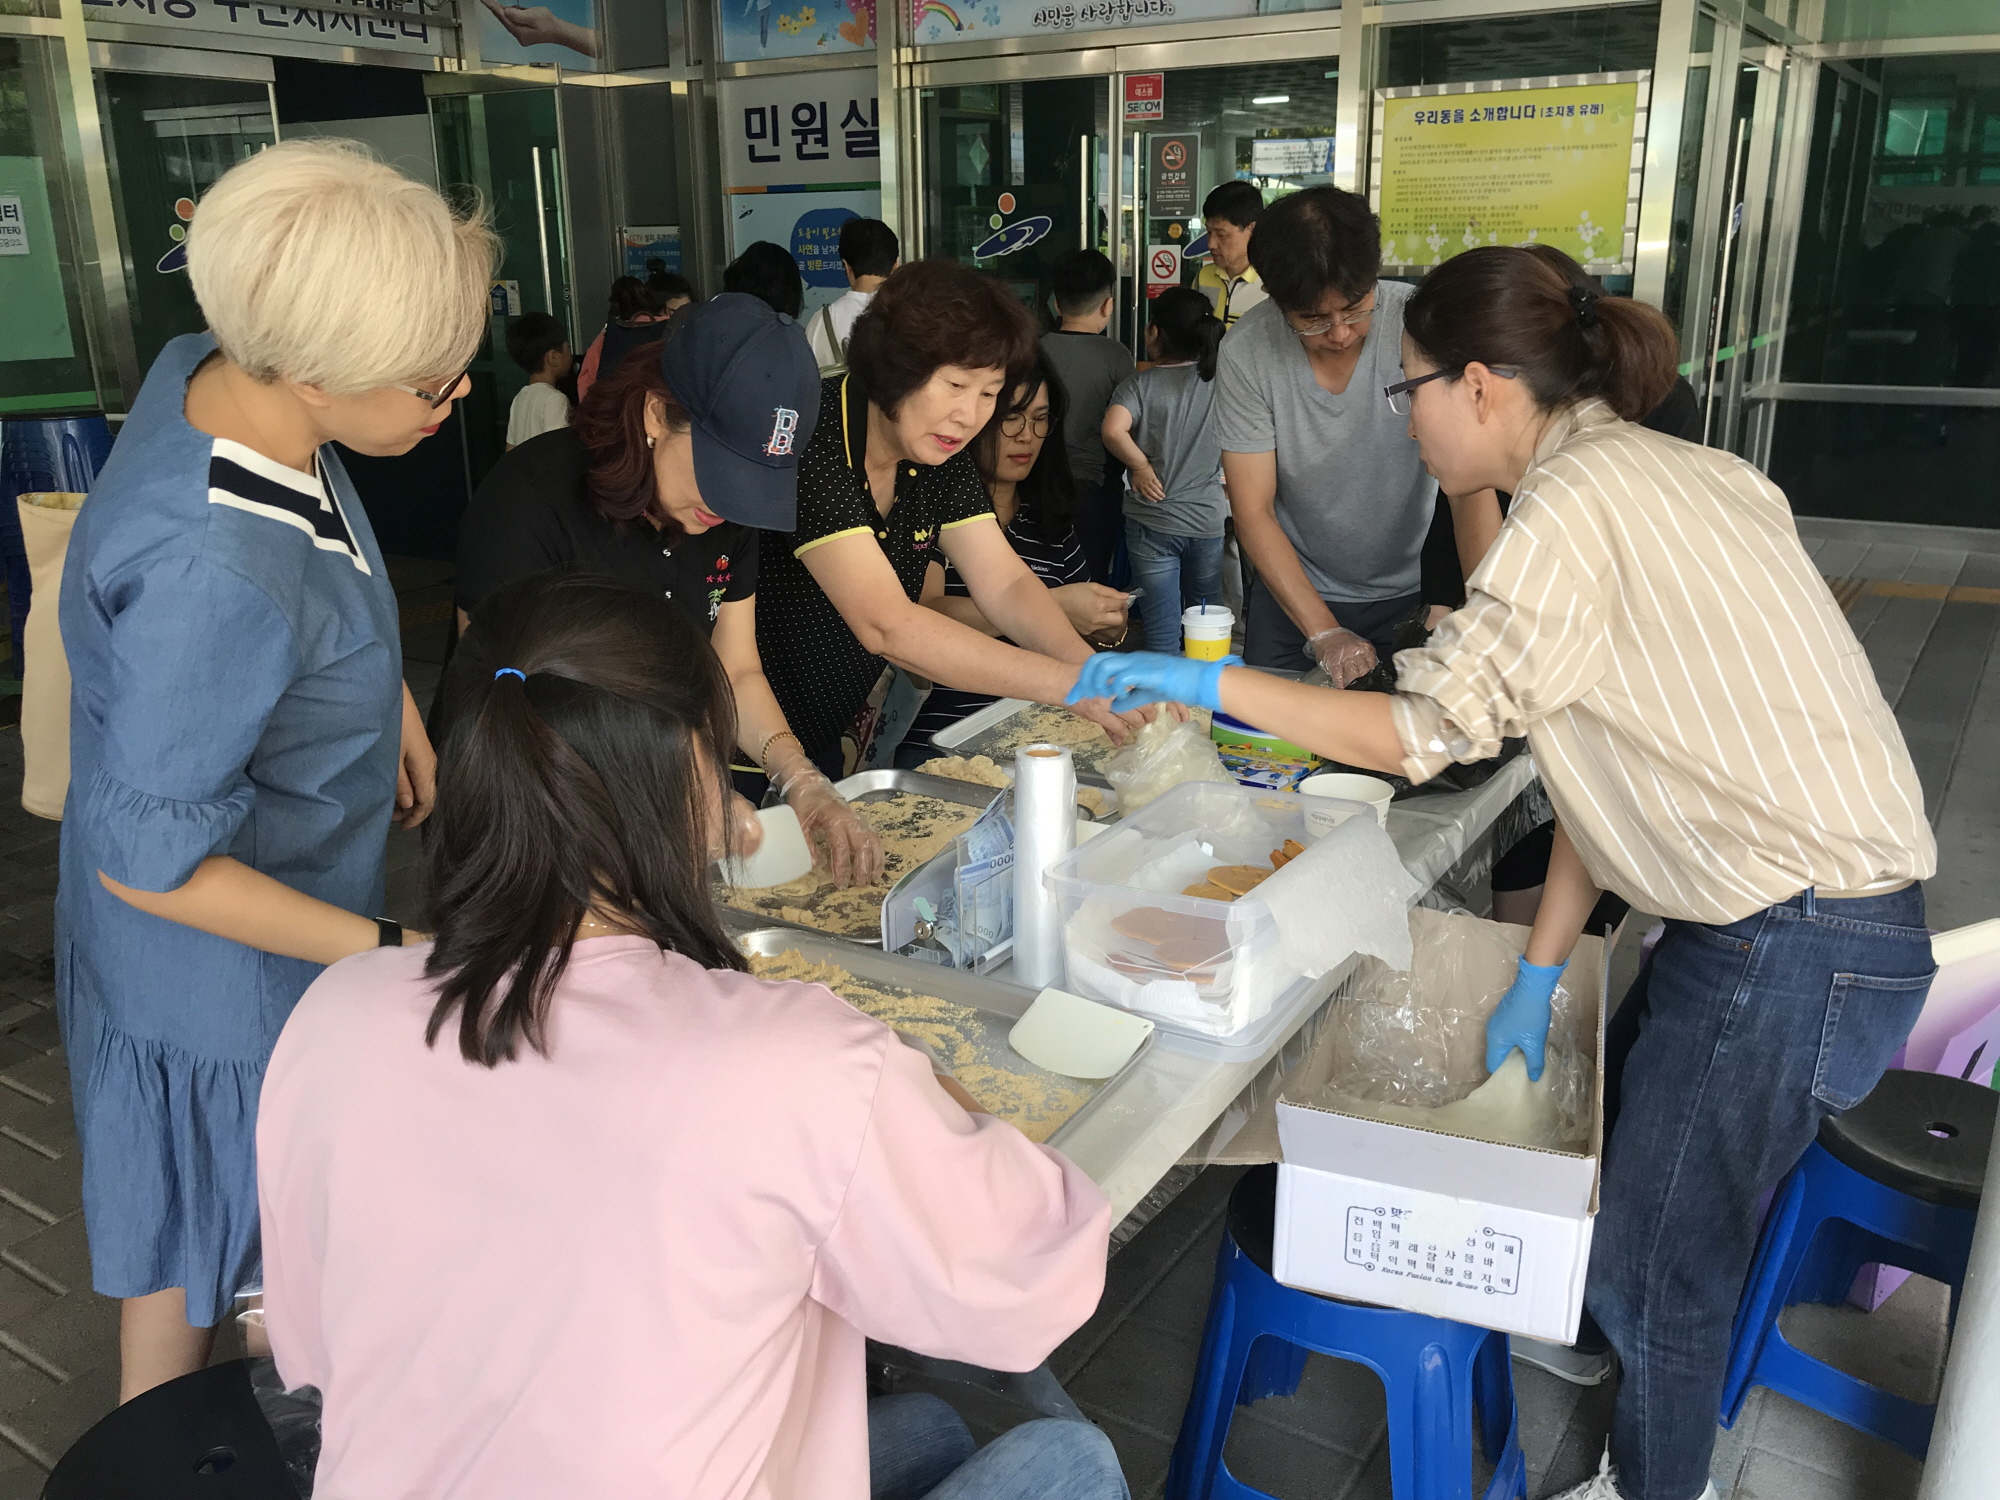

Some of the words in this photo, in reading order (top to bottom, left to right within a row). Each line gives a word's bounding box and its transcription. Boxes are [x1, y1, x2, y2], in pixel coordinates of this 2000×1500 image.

[1034, 4, 1075, 27] 시민을
[1080, 0, 1174, 22] 사랑합니다.
[1127, 101, 1161, 113] SECOM
[1414, 109, 1465, 126] 우리동을
[1469, 104, 1537, 123] 소개합니다
[744, 97, 880, 163] 민원실
[798, 226, 820, 240] 도움이
[797, 244, 820, 256] 사연을
[797, 261, 806, 271] 곧
[807, 259, 846, 271] 방문드리겠
[768, 408, 800, 455] B
[1381, 1266, 1404, 1276] Korea
[1405, 1271, 1432, 1282] Fusion
[1435, 1277, 1453, 1286] Cake
[1455, 1281, 1479, 1291] House
